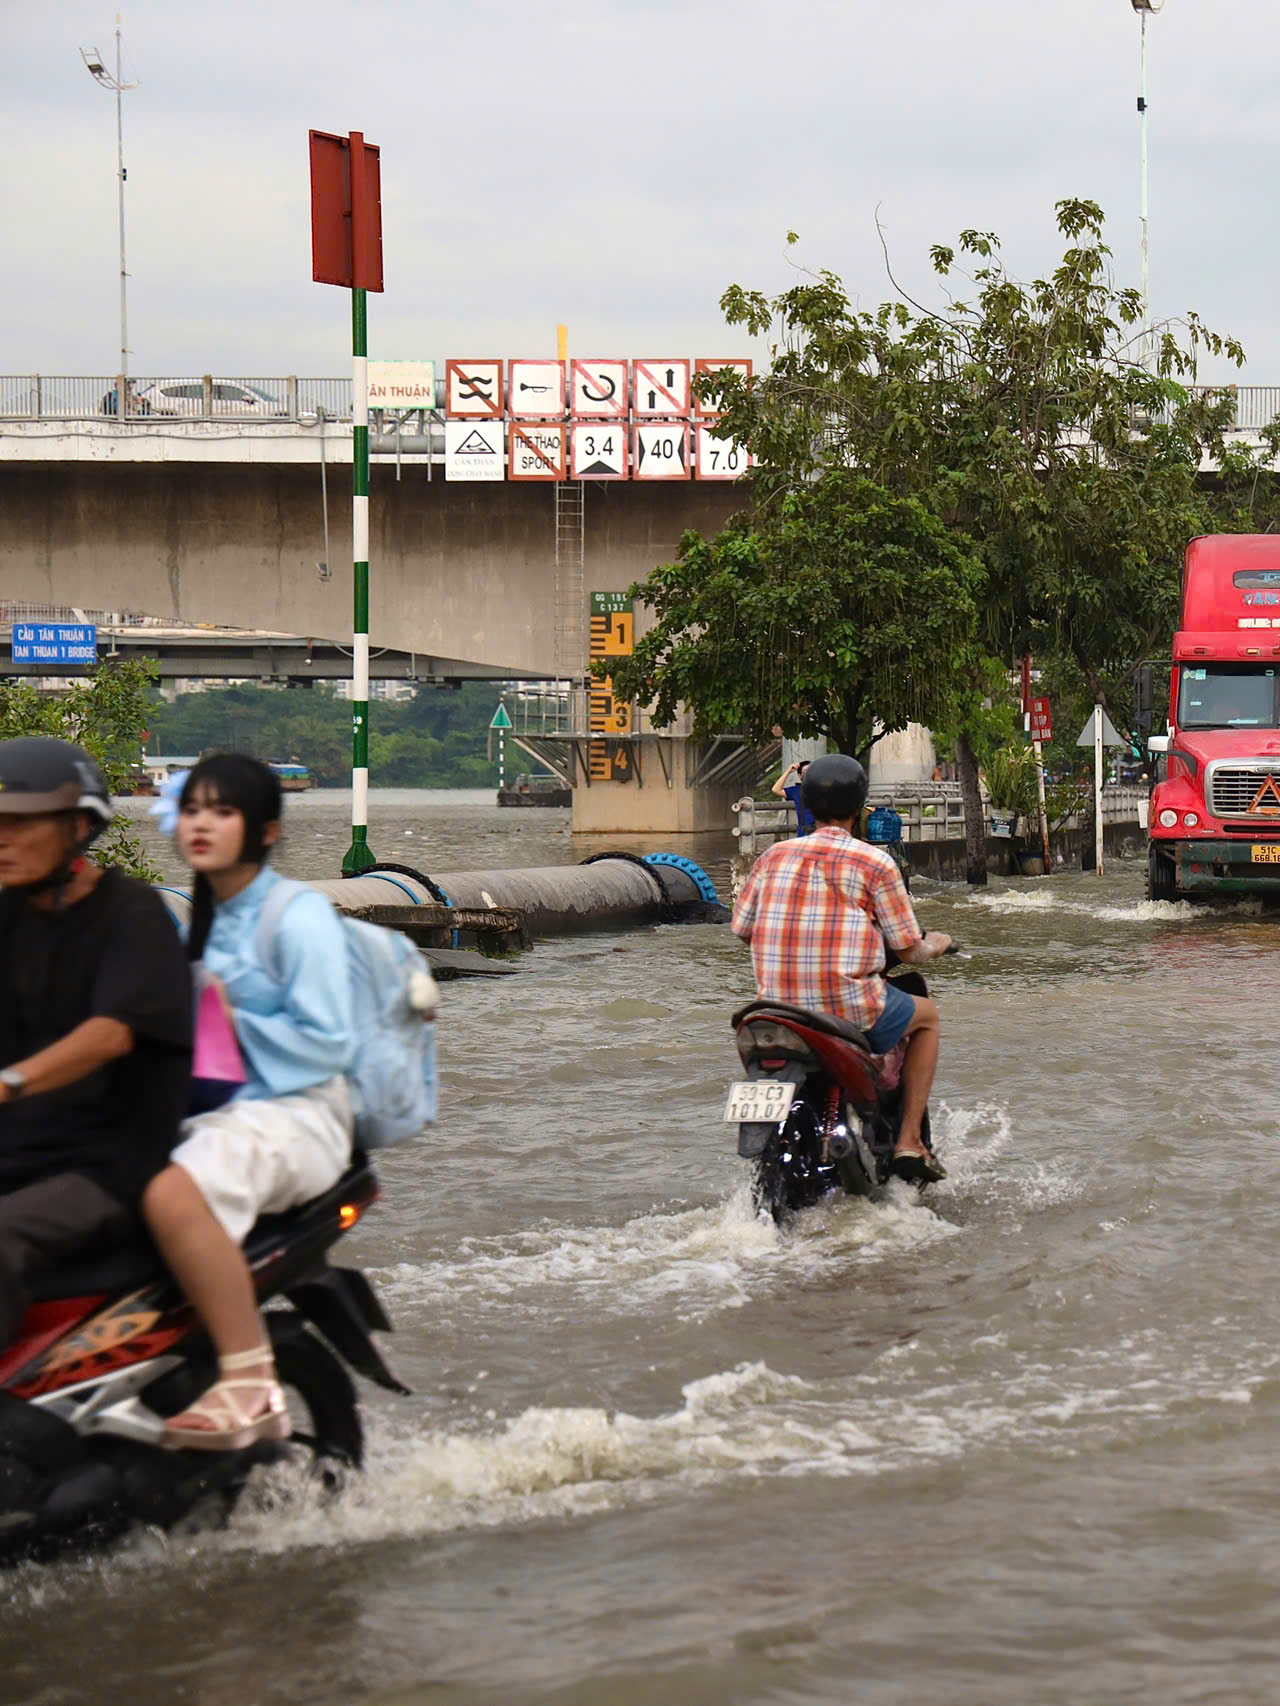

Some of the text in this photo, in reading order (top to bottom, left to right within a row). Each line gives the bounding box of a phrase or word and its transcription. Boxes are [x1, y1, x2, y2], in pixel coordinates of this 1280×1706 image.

[367, 383, 430, 400] ÂN THUẬN
[585, 436, 614, 456] 3.4
[651, 439, 673, 459] 40
[521, 457, 556, 470] SPORT
[710, 450, 739, 470] 7.0
[38, 627, 54, 641] TÂN
[58, 627, 84, 643] THUẬN
[87, 629, 92, 641] 1
[14, 645, 95, 658] TAN THUAN 1 BRIDGE
[615, 747, 628, 770] 4
[1260, 846, 1276, 855] 51C
[731, 1103, 786, 1120] 101.07
